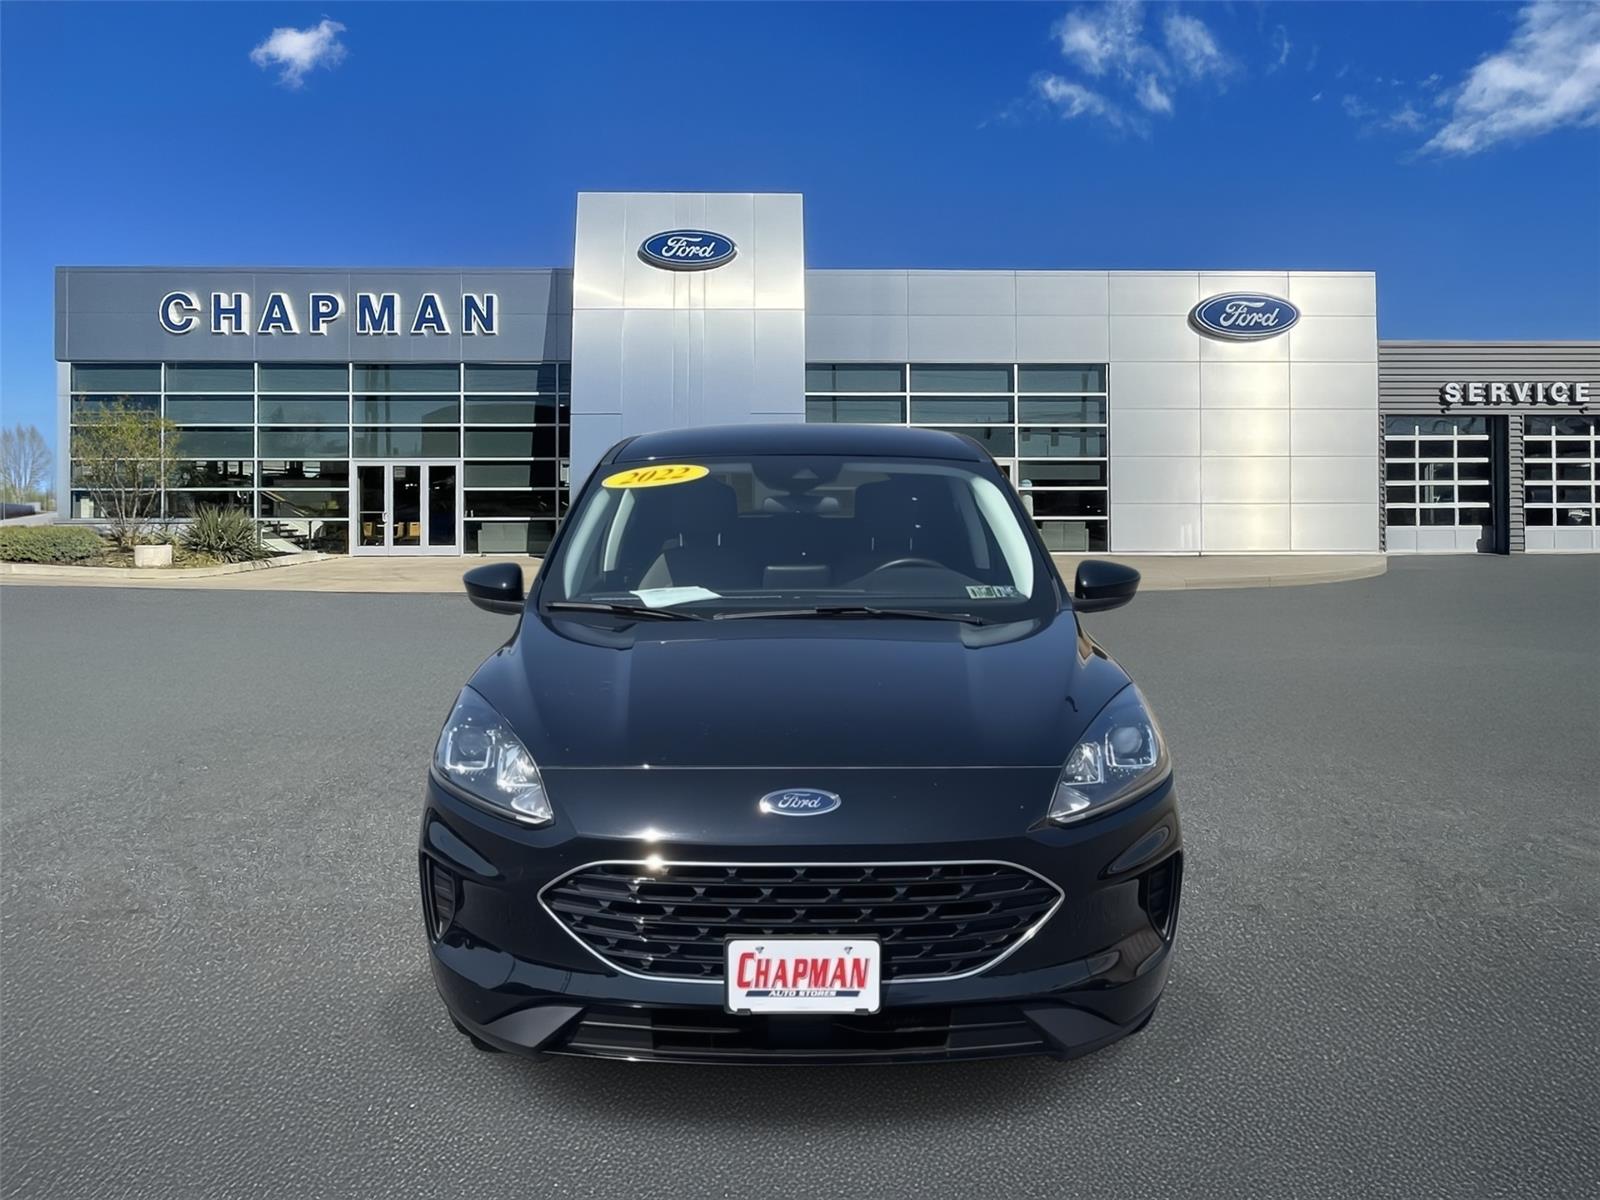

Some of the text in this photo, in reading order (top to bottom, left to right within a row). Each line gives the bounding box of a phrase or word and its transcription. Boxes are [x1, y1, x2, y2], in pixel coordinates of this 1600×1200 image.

[661, 236, 715, 258] Ford
[158, 291, 500, 336] CHAPMAN
[1219, 301, 1280, 327] Ford
[1444, 382, 1591, 403] SERVICE
[619, 467, 691, 485] 2022
[777, 792, 822, 809] Ford
[736, 952, 870, 989] CHAPMAN
